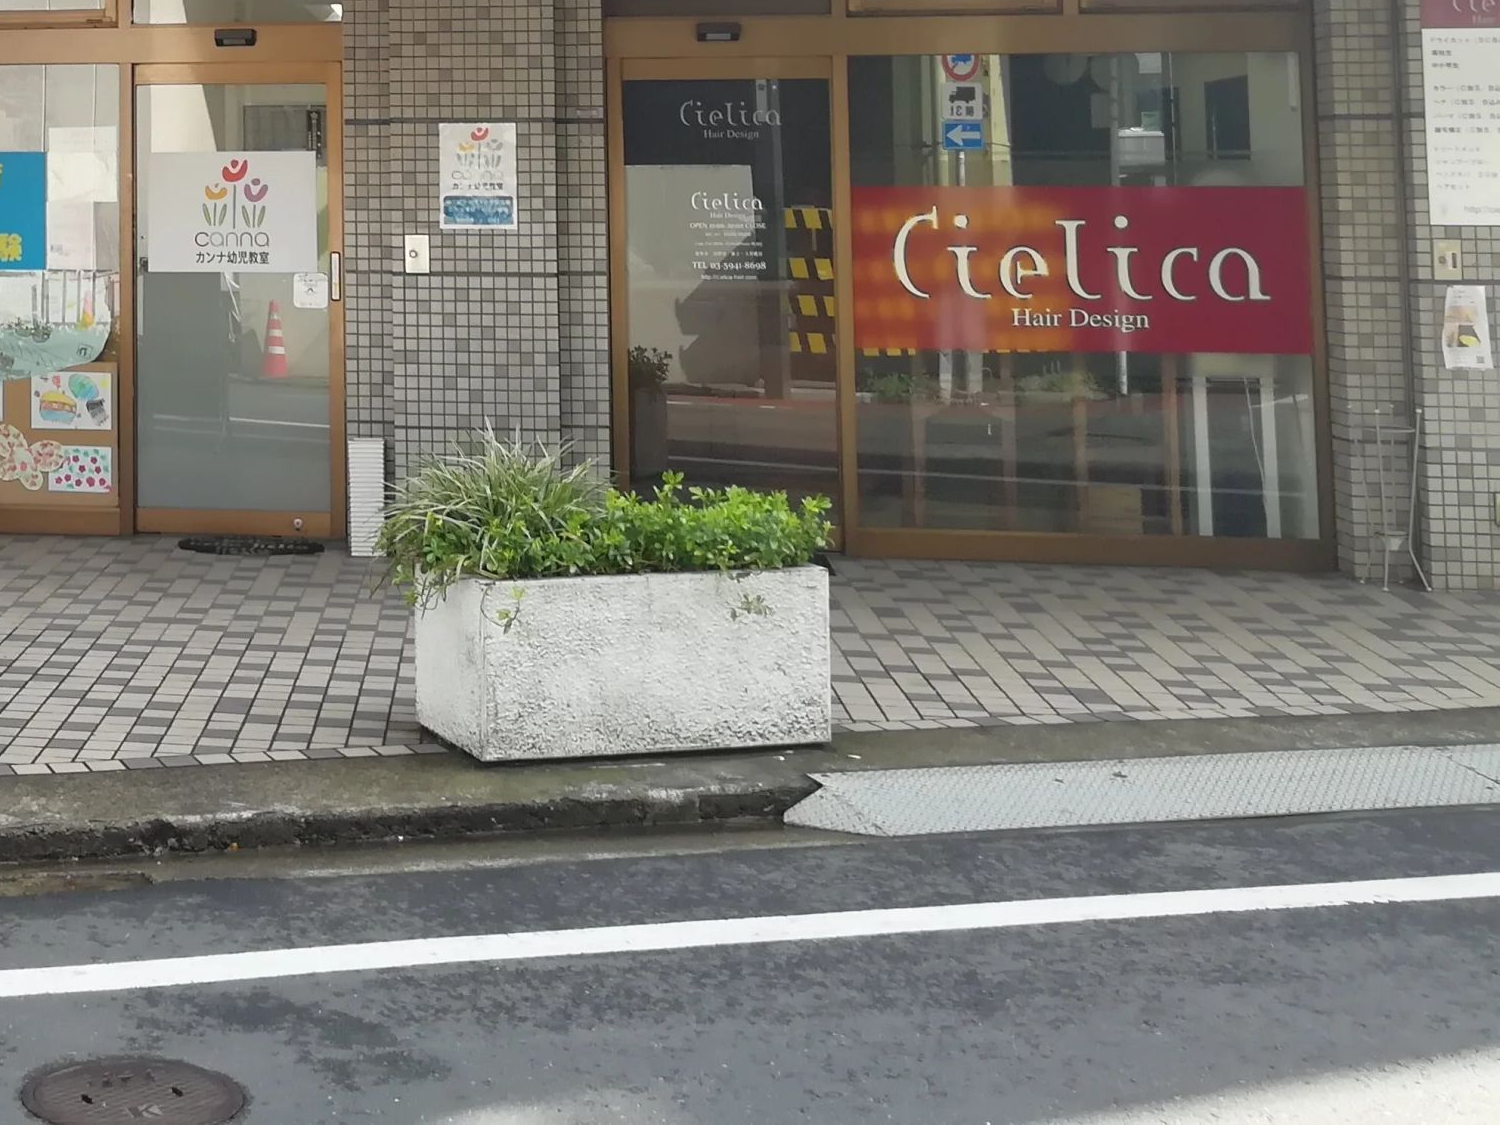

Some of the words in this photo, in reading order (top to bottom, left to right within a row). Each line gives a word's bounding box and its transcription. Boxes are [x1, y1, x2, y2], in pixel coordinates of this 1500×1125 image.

[680, 98, 782, 126] Cielica
[691, 191, 763, 210] Cielica
[194, 230, 270, 248] canna
[195, 250, 270, 265] カンナ幼児教室
[892, 205, 1271, 301] Cielica
[692, 261, 708, 269] TEL
[1011, 308, 1063, 328] Hair
[1068, 308, 1150, 333] Design
